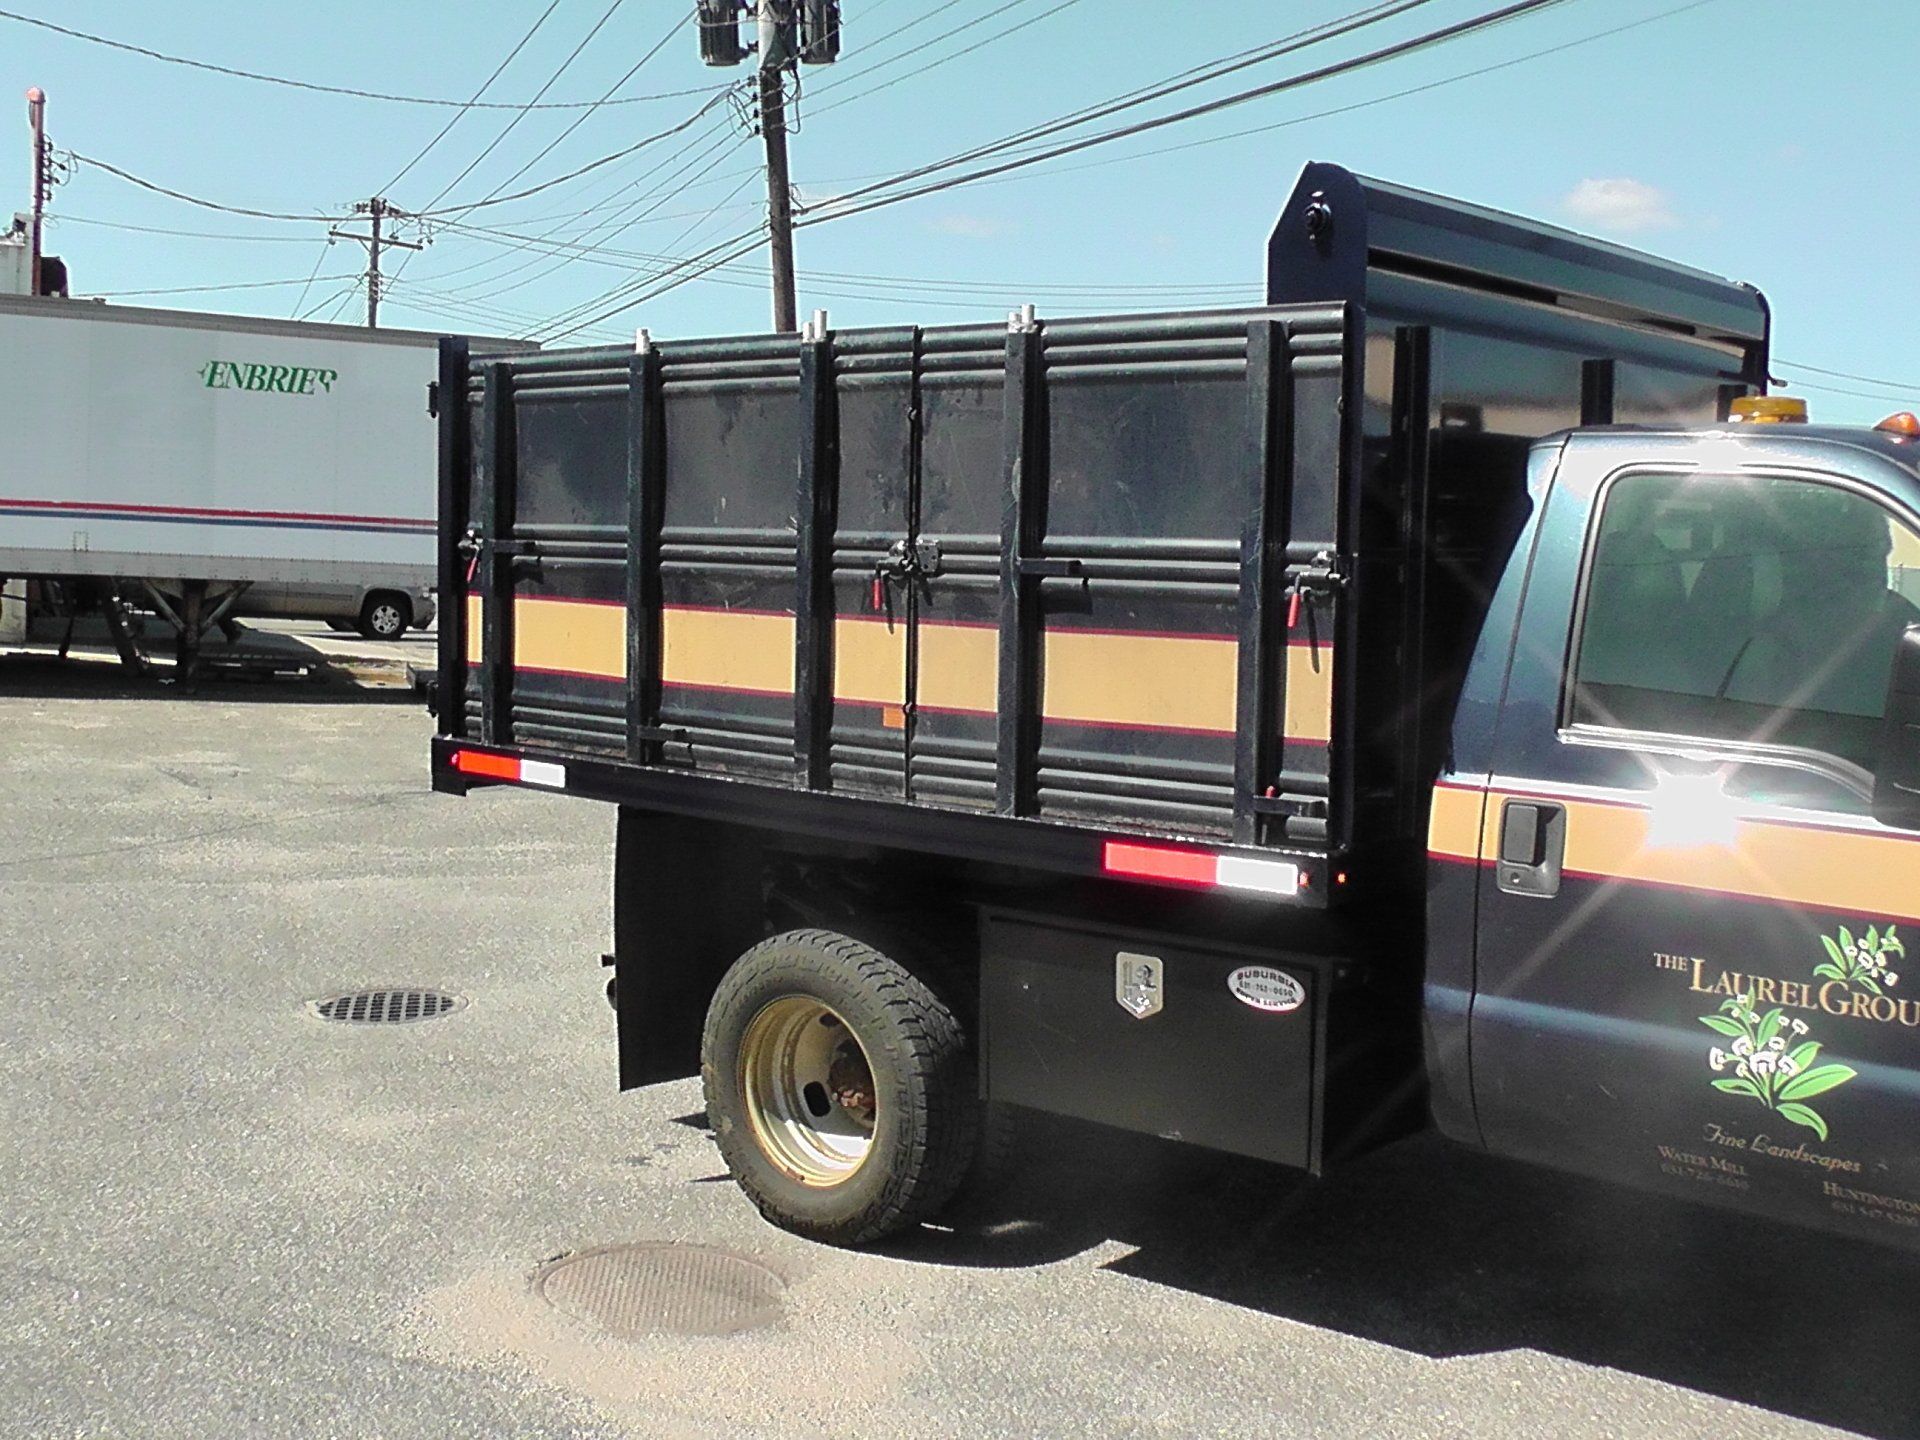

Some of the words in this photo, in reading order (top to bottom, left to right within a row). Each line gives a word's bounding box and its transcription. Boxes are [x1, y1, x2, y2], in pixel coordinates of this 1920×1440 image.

[1653, 952, 1688, 972] THE
[1702, 1122, 1747, 1149] Fine
[1750, 1133, 1862, 1174] Landscapes
